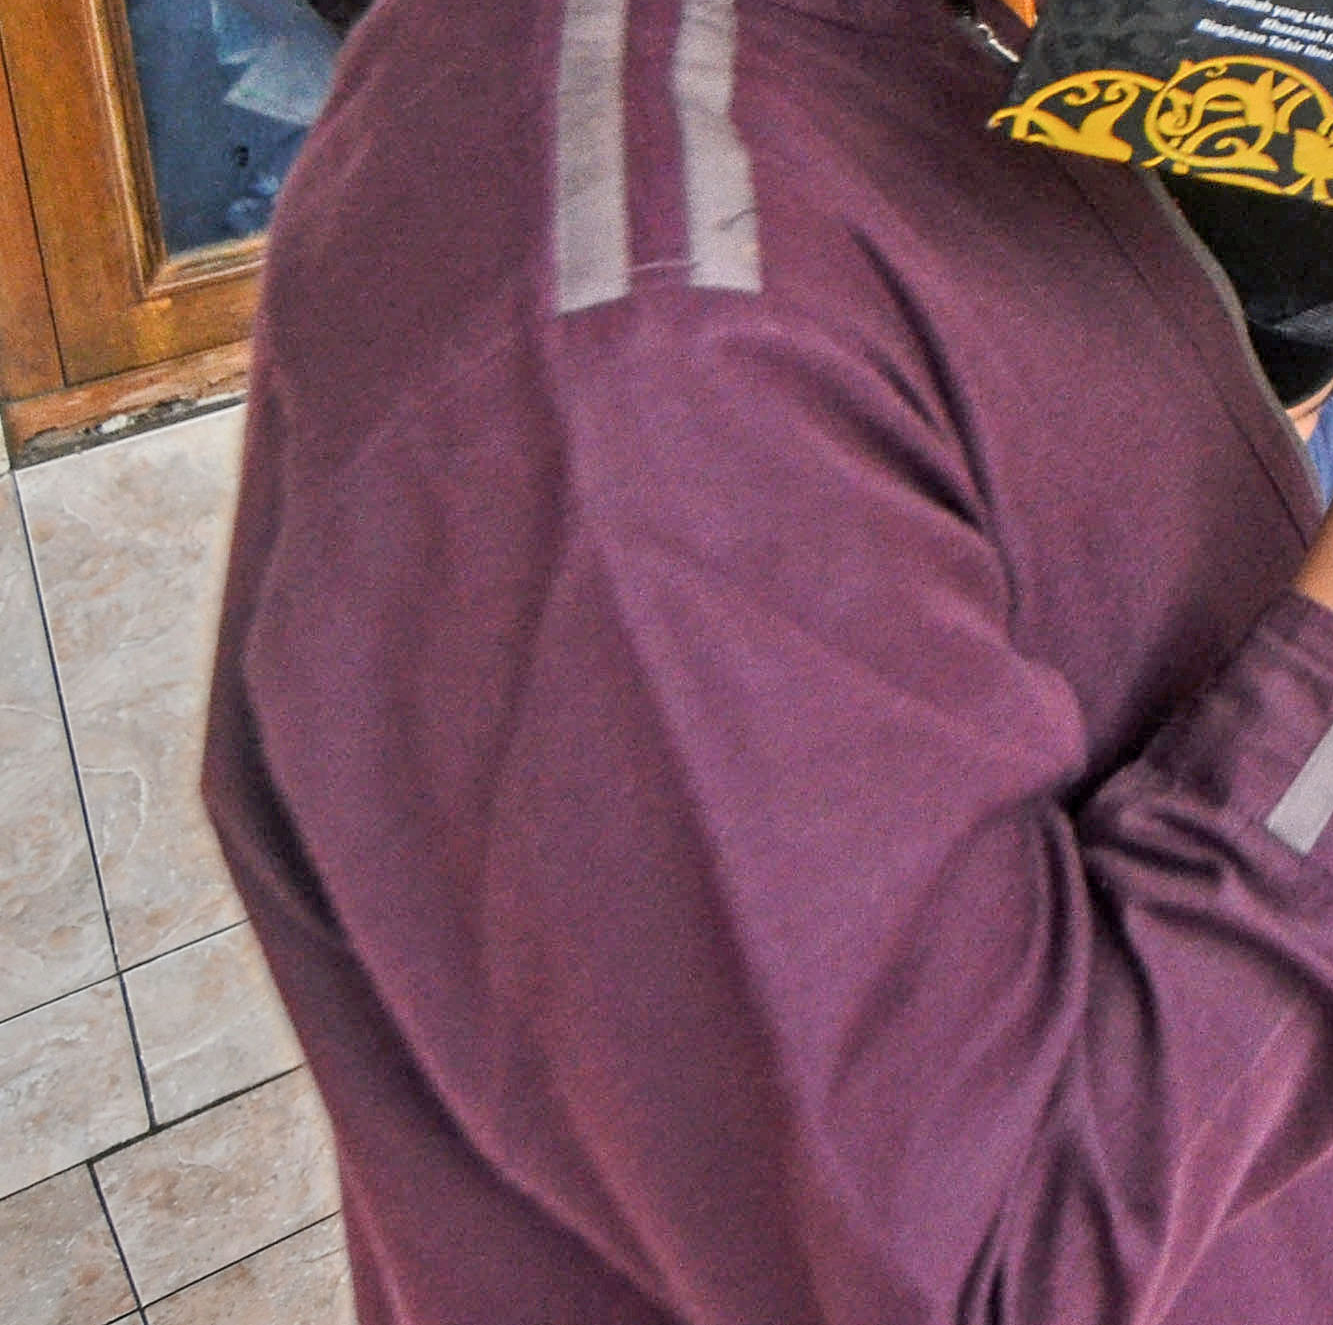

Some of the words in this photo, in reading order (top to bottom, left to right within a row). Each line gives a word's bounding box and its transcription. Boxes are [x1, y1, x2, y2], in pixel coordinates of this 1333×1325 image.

[1272, 5, 1307, 24] yang
[1197, 18, 1267, 45] Ringkasan
[1268, 35, 1304, 54] Tafsir
[1260, 17, 1326, 43] Khazanah
